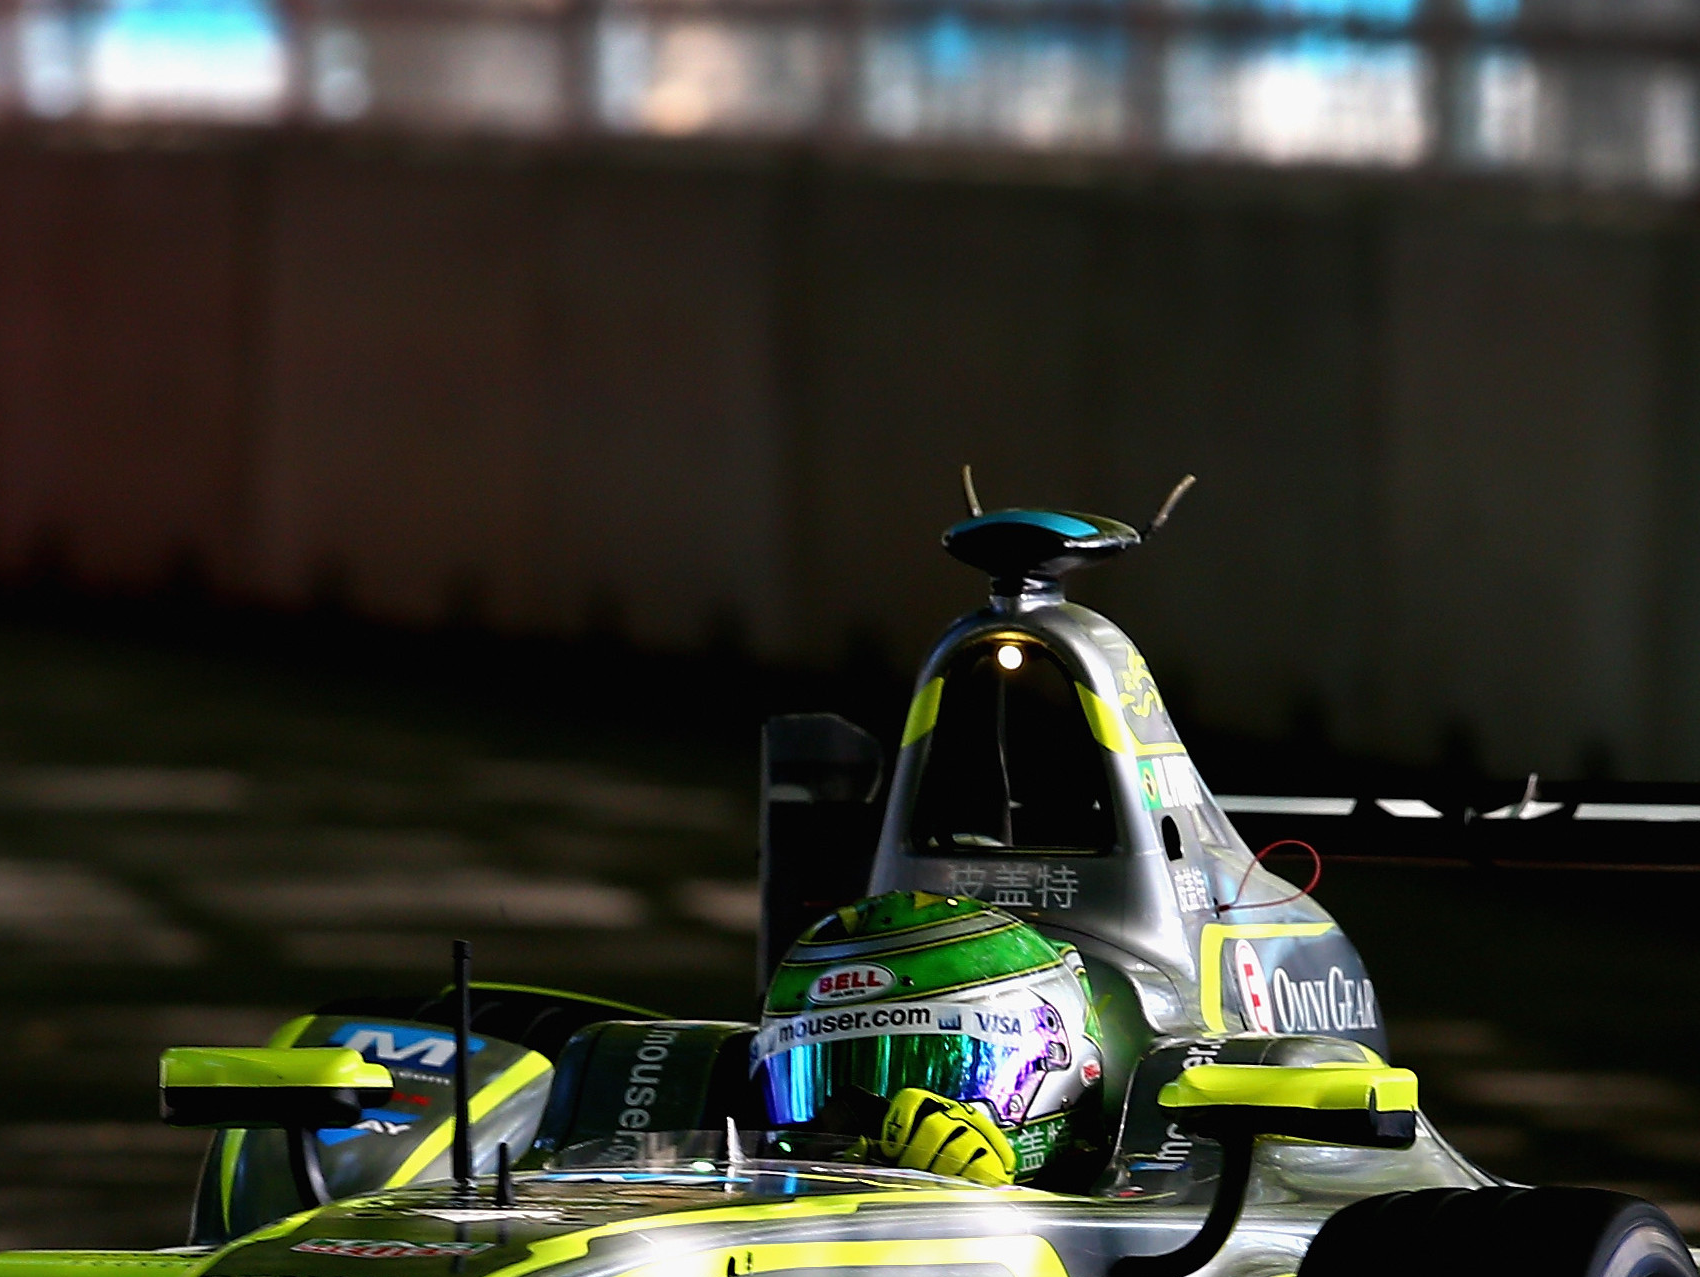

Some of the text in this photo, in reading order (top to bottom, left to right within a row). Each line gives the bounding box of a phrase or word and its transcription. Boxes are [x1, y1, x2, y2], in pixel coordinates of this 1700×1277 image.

[818, 970, 883, 994] BELL
[778, 1006, 931, 1043] mouser.com
[975, 1011, 1023, 1037] VISA
